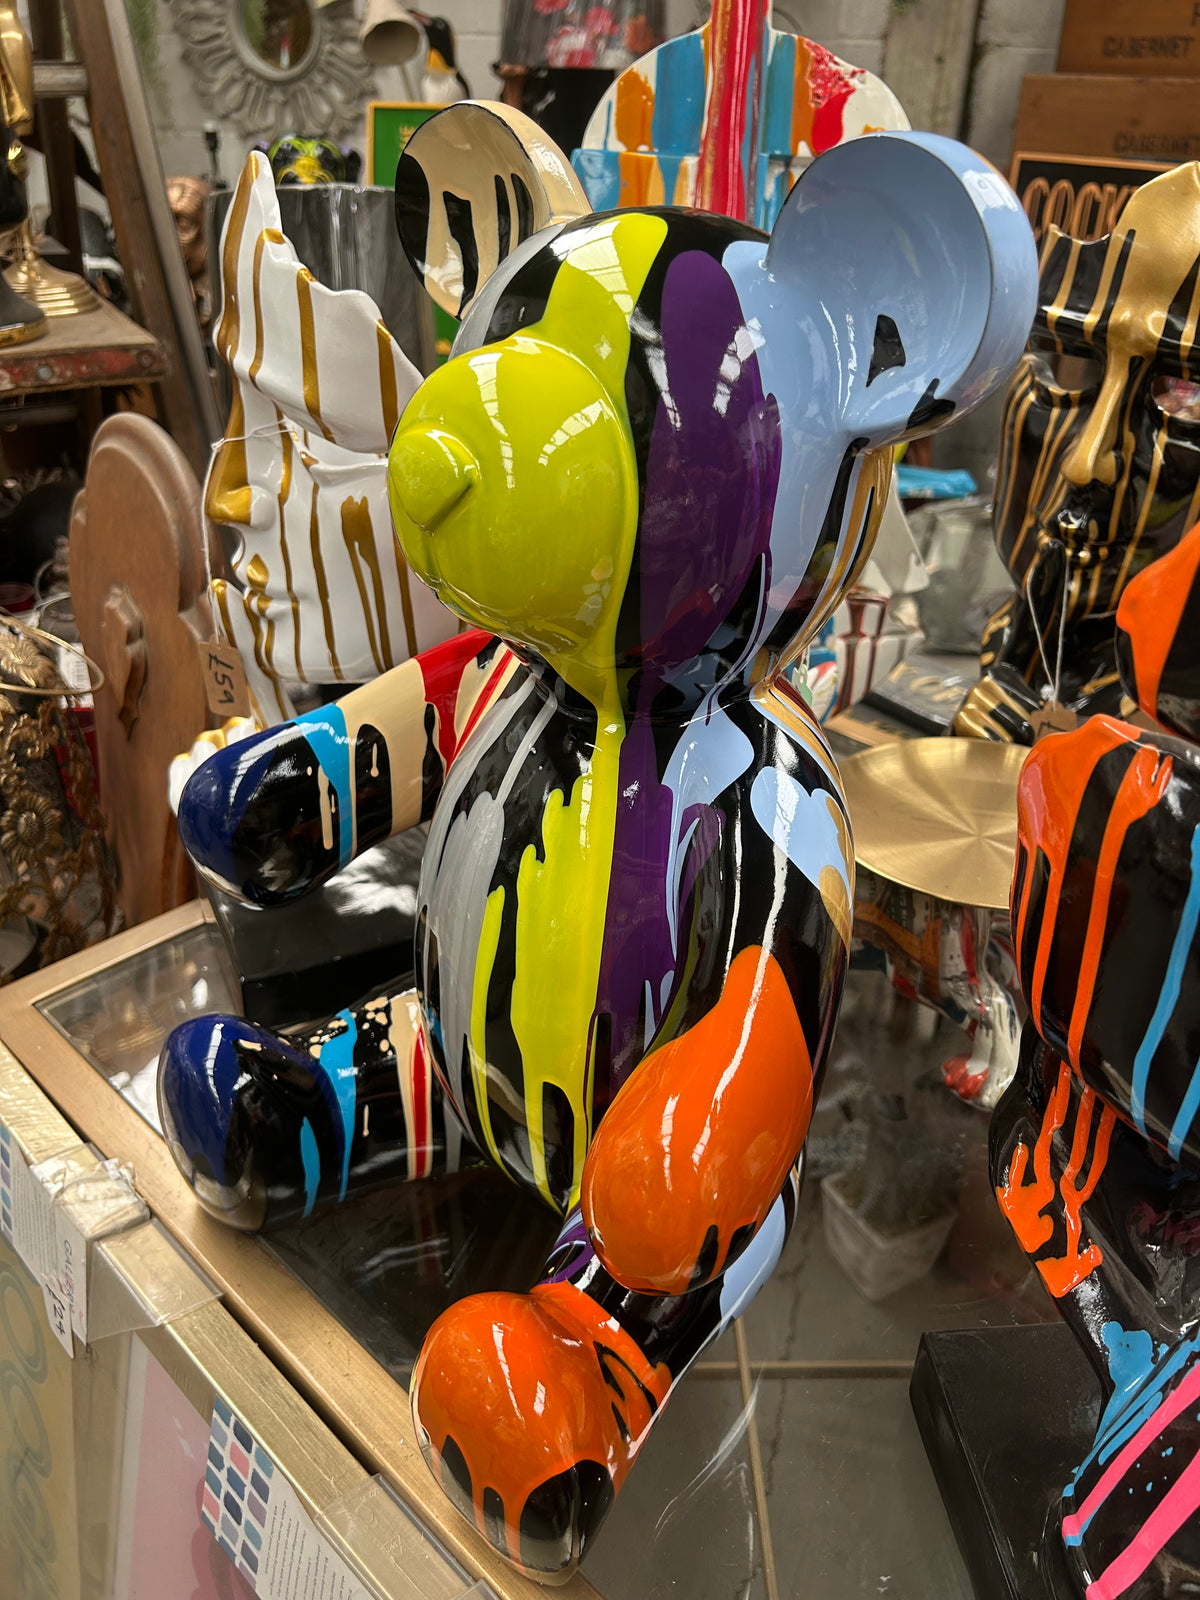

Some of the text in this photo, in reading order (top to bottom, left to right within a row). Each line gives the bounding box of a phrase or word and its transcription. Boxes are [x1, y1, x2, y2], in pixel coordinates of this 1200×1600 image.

[1103, 36, 1195, 59] CABERNET
[208, 652, 235, 704] £59
[45, 1283, 66, 1335] £24
